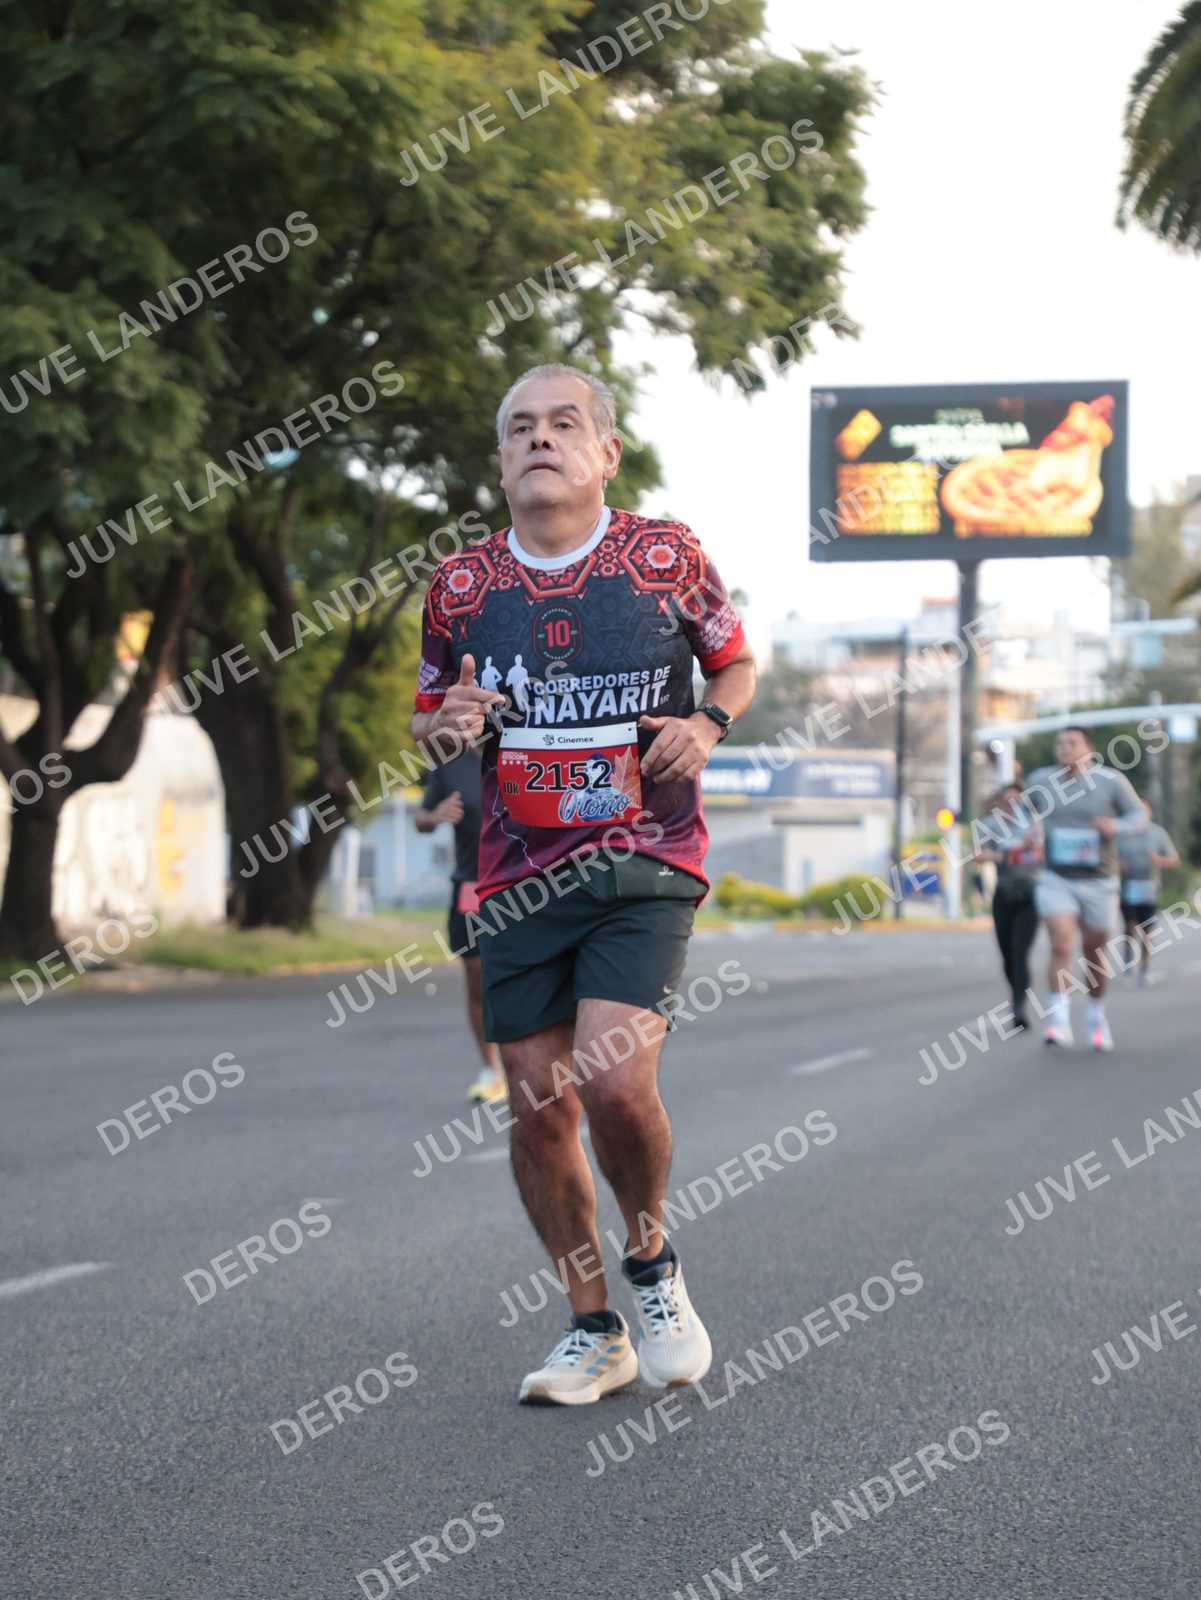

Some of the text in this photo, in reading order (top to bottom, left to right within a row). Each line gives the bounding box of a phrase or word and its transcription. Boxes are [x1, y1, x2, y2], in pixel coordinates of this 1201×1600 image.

[544, 619, 571, 649] 10
[533, 665, 672, 696] CORREDORES DE
[534, 679, 668, 726] NAYARIT
[557, 736, 594, 744] Cinemex
[525, 760, 613, 792] 2152
